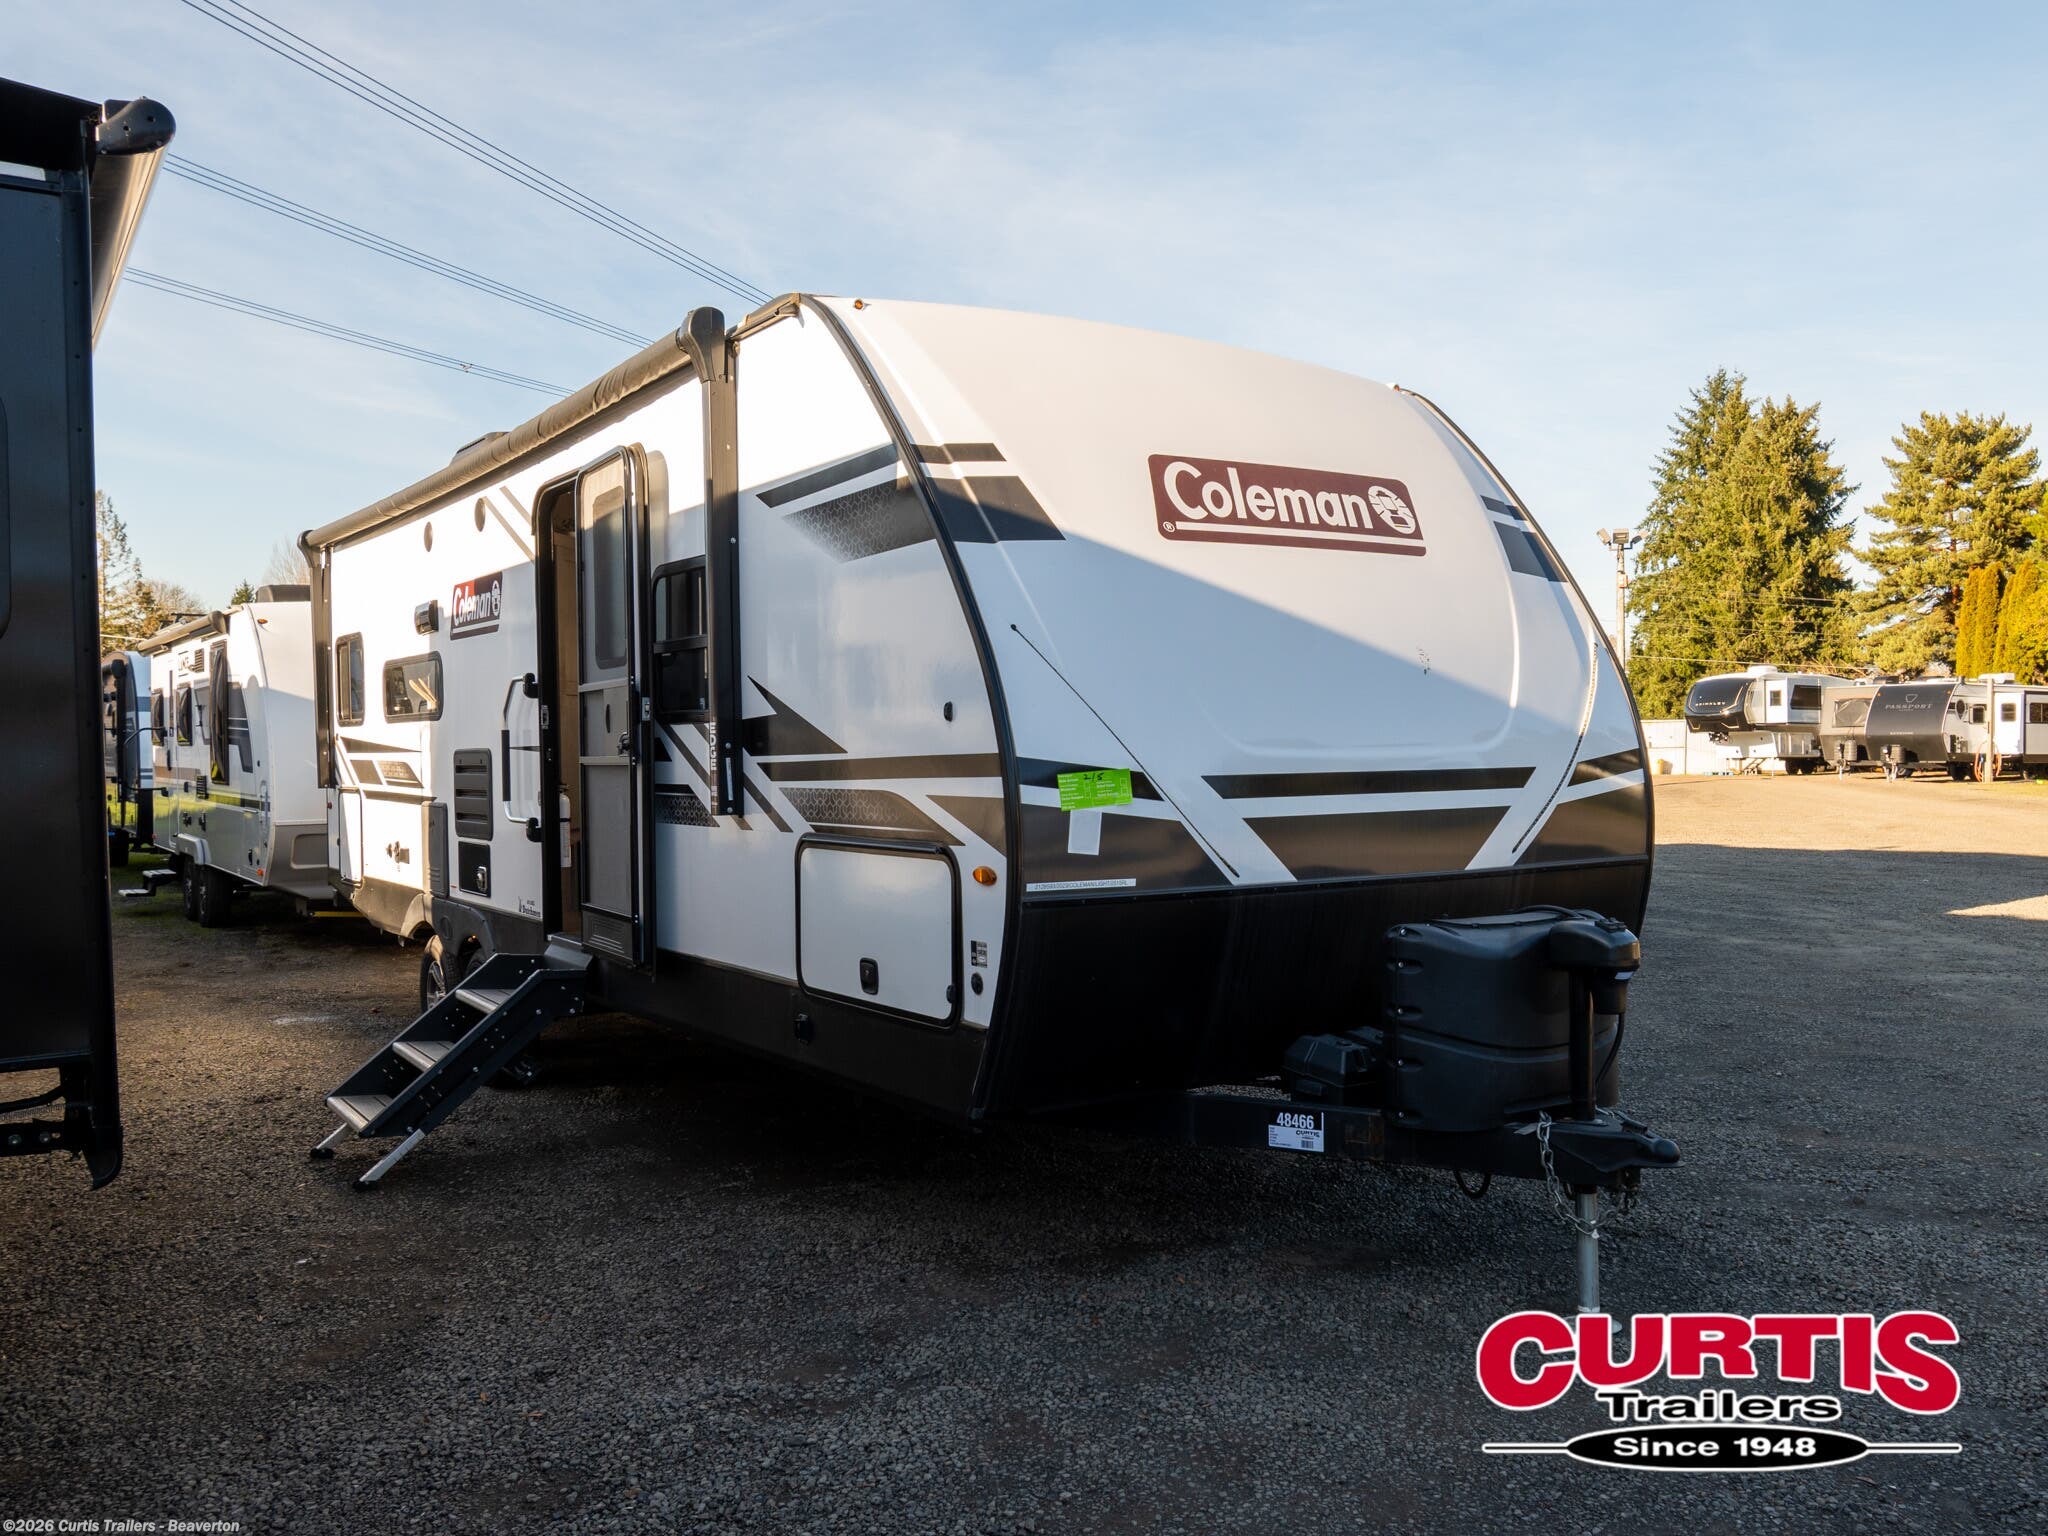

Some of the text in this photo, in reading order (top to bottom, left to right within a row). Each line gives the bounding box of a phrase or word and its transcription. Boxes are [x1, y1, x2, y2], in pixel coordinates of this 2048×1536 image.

[1164, 461, 1373, 529] Coleman
[453, 585, 491, 626] Coleman
[1276, 1112, 1315, 1130] 48466
